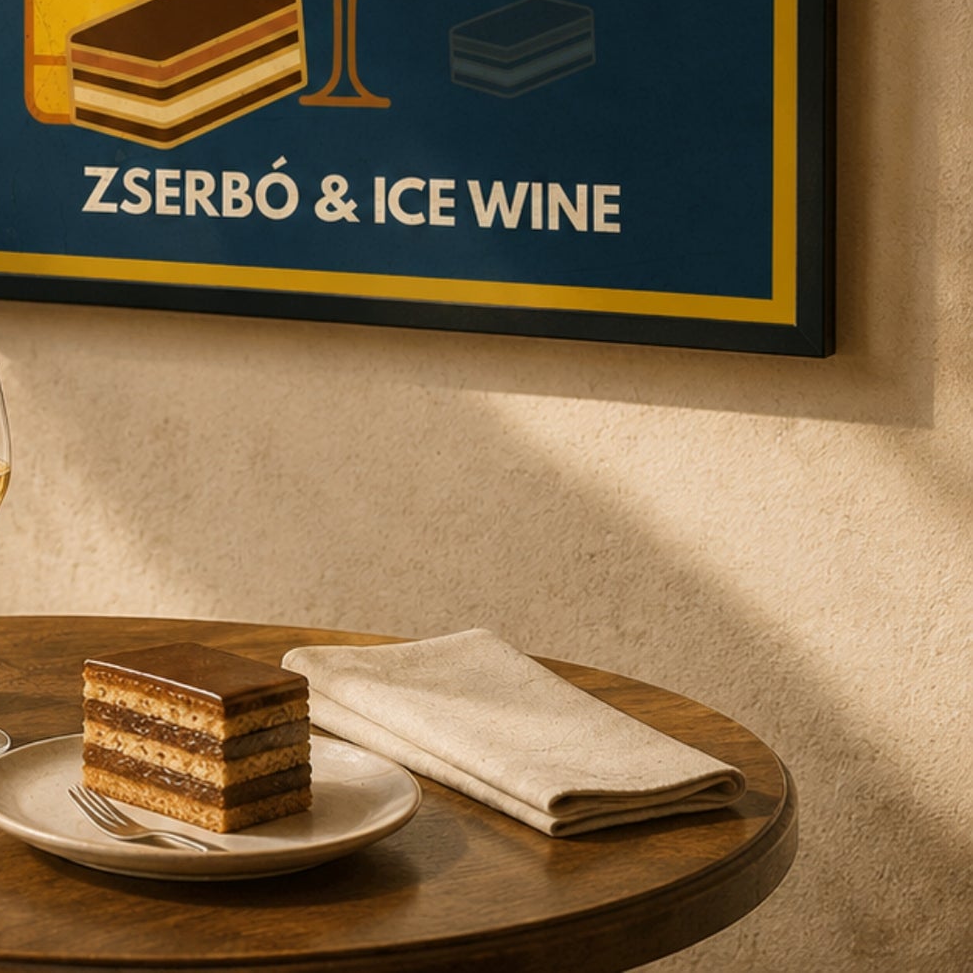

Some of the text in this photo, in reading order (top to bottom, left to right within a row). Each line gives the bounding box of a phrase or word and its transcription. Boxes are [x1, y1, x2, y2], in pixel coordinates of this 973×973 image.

[82, 156, 622, 233] ZSERBÓ & ICE WINE
